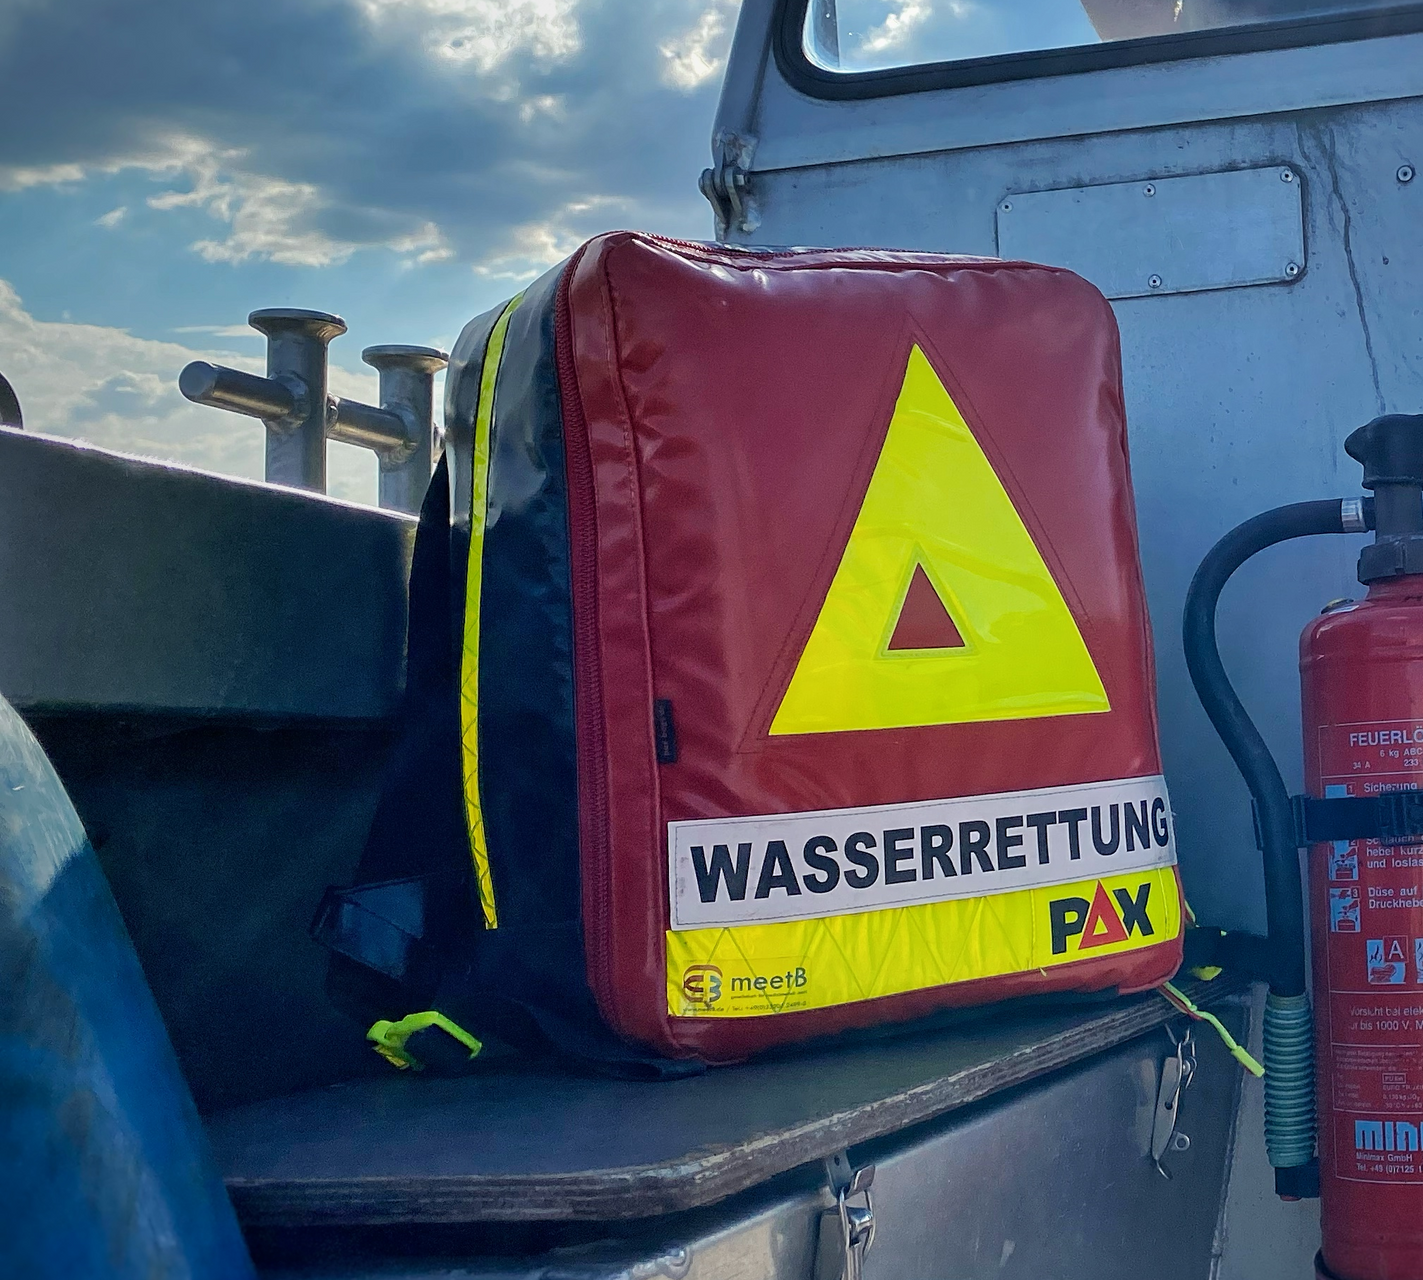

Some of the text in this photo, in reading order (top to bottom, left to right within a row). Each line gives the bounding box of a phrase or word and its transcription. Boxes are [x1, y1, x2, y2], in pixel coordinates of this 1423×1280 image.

[1380, 750, 1386, 758] 6
[1388, 748, 1400, 759] kg
[690, 796, 1169, 902] WASSERRETTUNG
[1366, 847, 1394, 857] hebel
[1400, 846, 1423, 856] kurz
[1367, 857, 1387, 868] und
[1368, 886, 1394, 898] Düse
[1400, 885, 1418, 896] auf
[1049, 879, 1153, 955] PAX
[1389, 940, 1405, 959] A
[731, 967, 808, 991] meetB
[1360, 1019, 1373, 1031] bis
[1376, 1020, 1398, 1031] 1000
[1356, 1151, 1385, 1162] Minimax
[1387, 1153, 1413, 1162] GmbH
